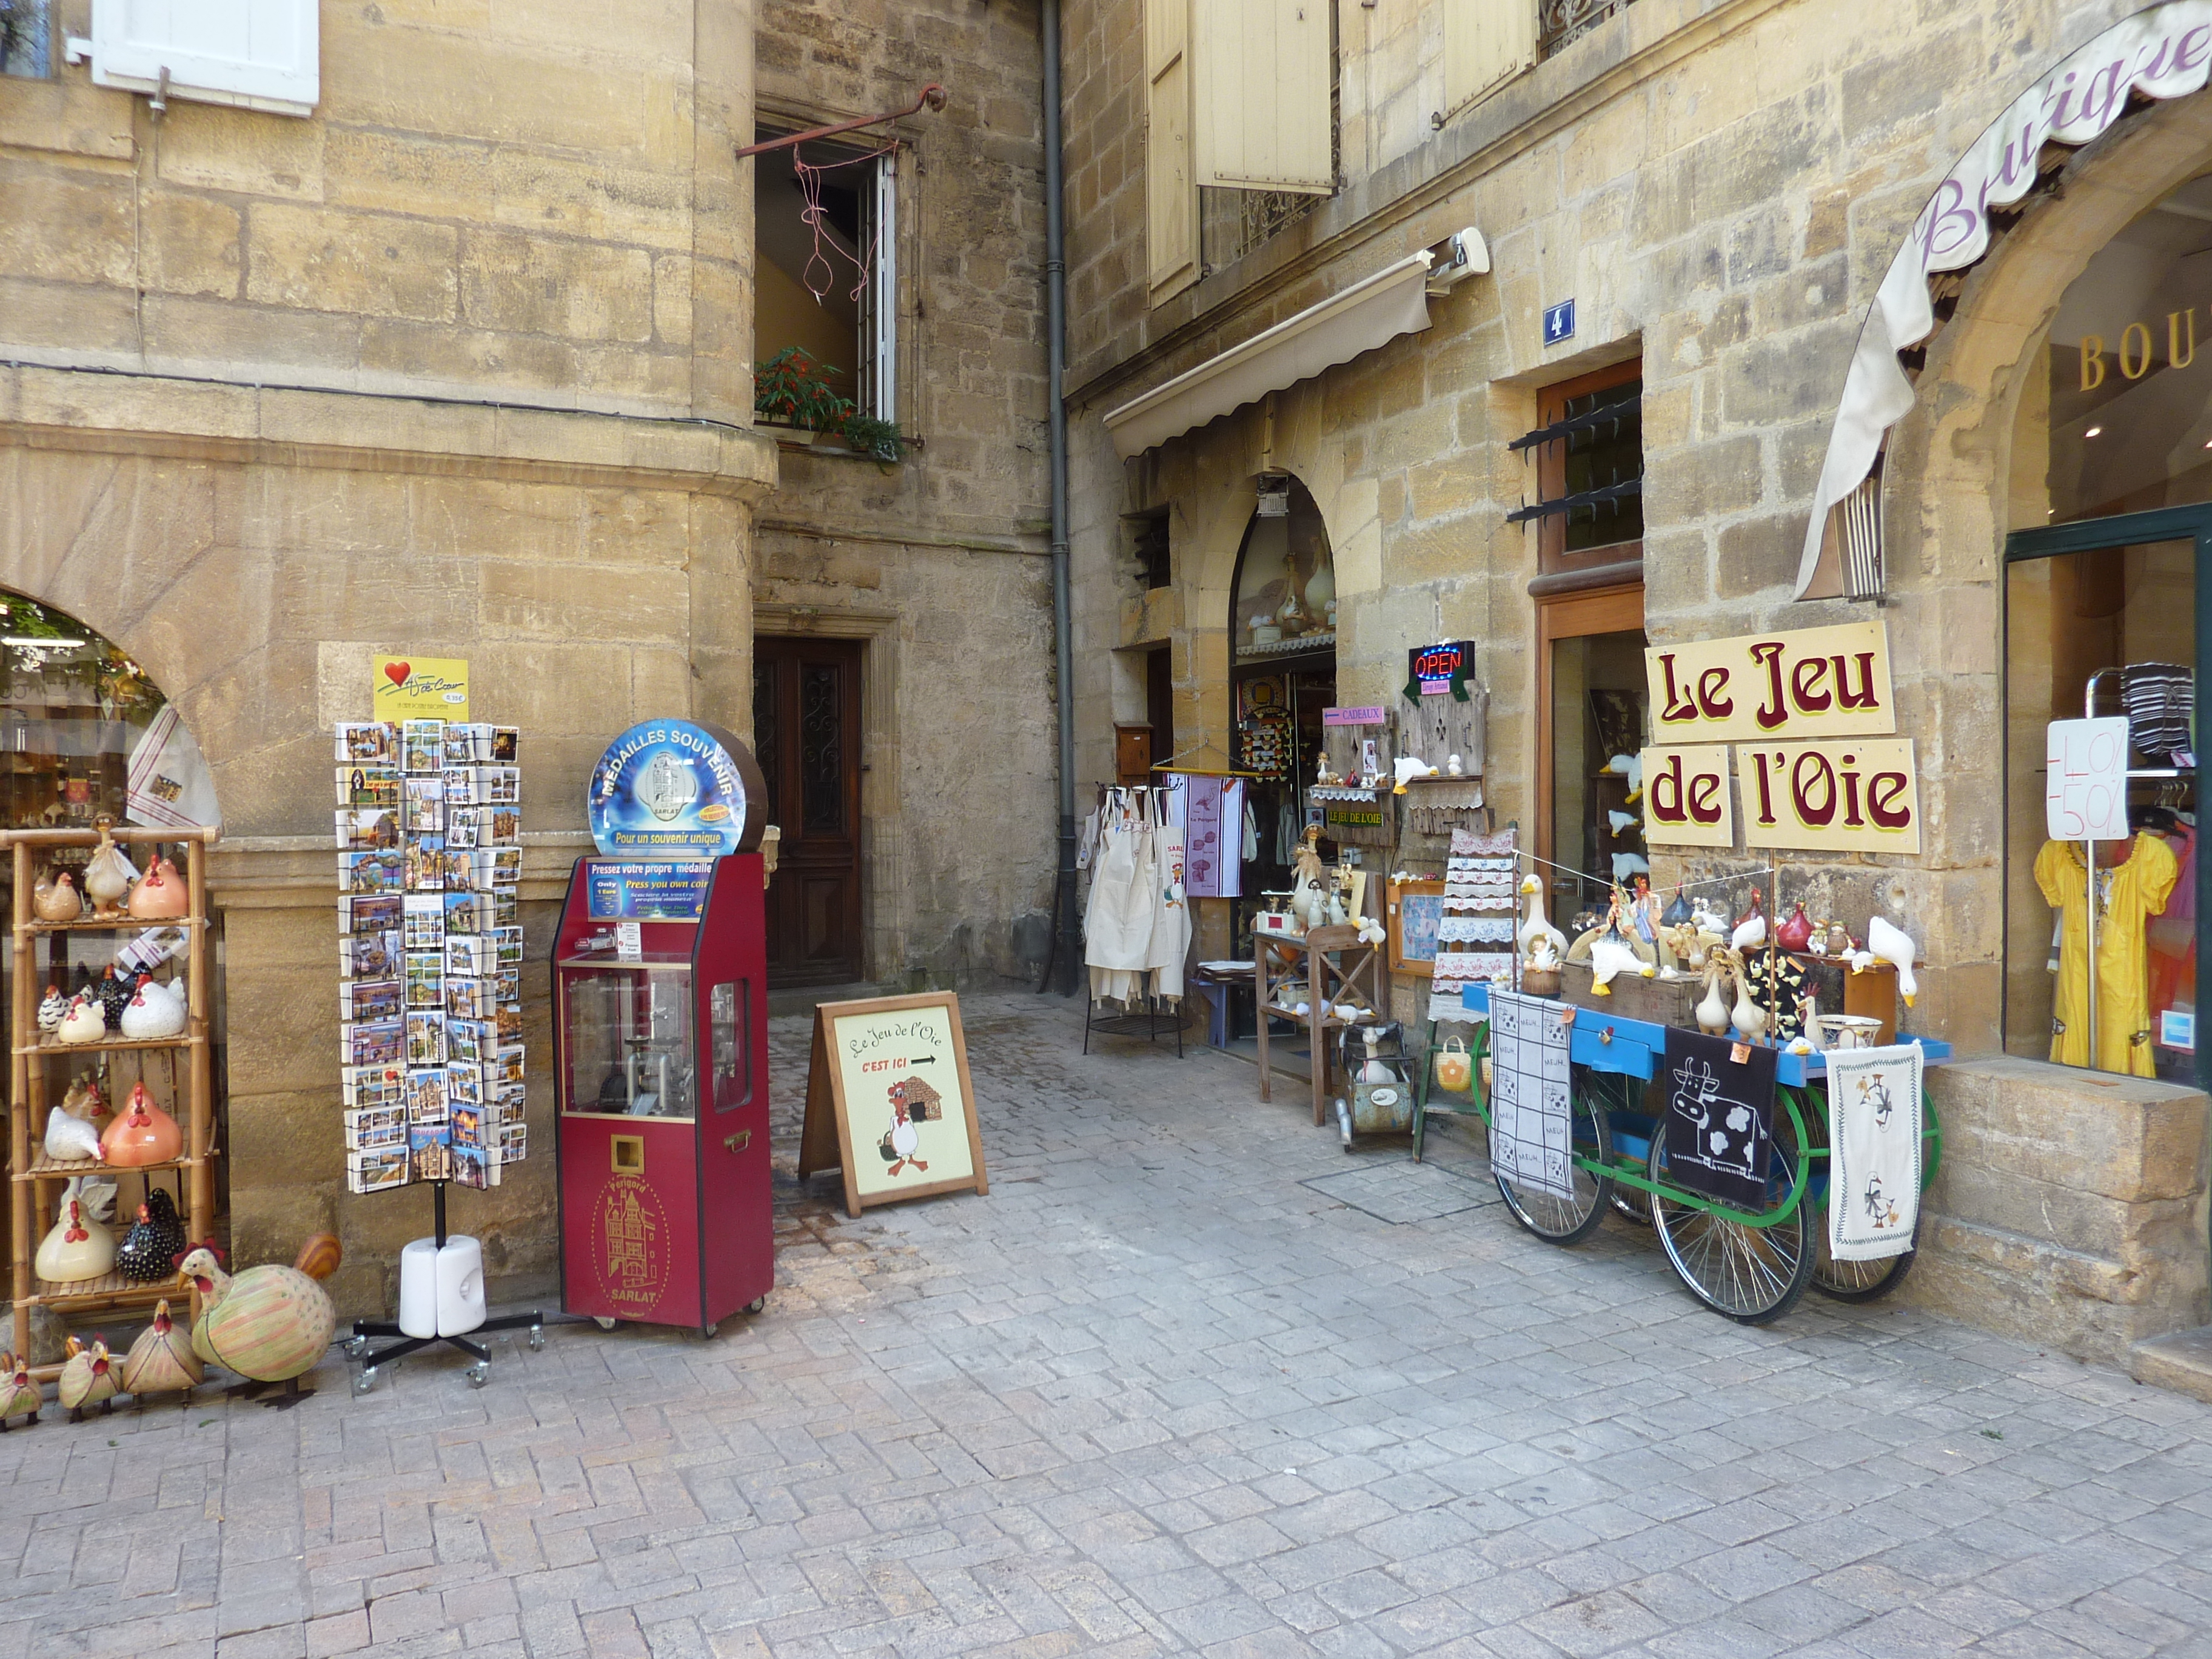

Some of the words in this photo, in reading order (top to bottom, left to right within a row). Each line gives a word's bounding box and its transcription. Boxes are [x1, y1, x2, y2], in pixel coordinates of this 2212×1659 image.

[1552, 309, 1562, 337] 4
[2079, 304, 2212, 392] BOU
[1415, 651, 1462, 676] OPEN
[1658, 654, 1734, 722] Le
[1749, 642, 1880, 730] Jeu
[1342, 708, 1379, 720] CADEAUX
[602, 729, 666, 797] MEDAILLES
[671, 730, 732, 796] SOUVENIR
[1651, 755, 1722, 825] de
[1752, 751, 1911, 831] l'Oie
[1330, 811, 1338, 821] LE
[1338, 812, 1349, 824] JEU
[1350, 813, 1360, 823] DE
[616, 833, 635, 843] Pour
[638, 834, 648, 843] un
[650, 832, 688, 844] souvenir
[690, 832, 721, 846] unique
[592, 865, 620, 874] Pressez
[622, 864, 643, 874] votre
[645, 865, 672, 876] propre
[677, 863, 711, 873] médaille
[651, 881, 668, 890] you
[850, 1040, 868, 1058] Le
[867, 1026, 892, 1047] Jeu
[894, 1024, 907, 1036] de
[911, 1021, 942, 1046] l'Oie
[862, 1060, 889, 1073] C'EST
[893, 1057, 907, 1069] ICI
[611, 1289, 656, 1303] SARLAT
